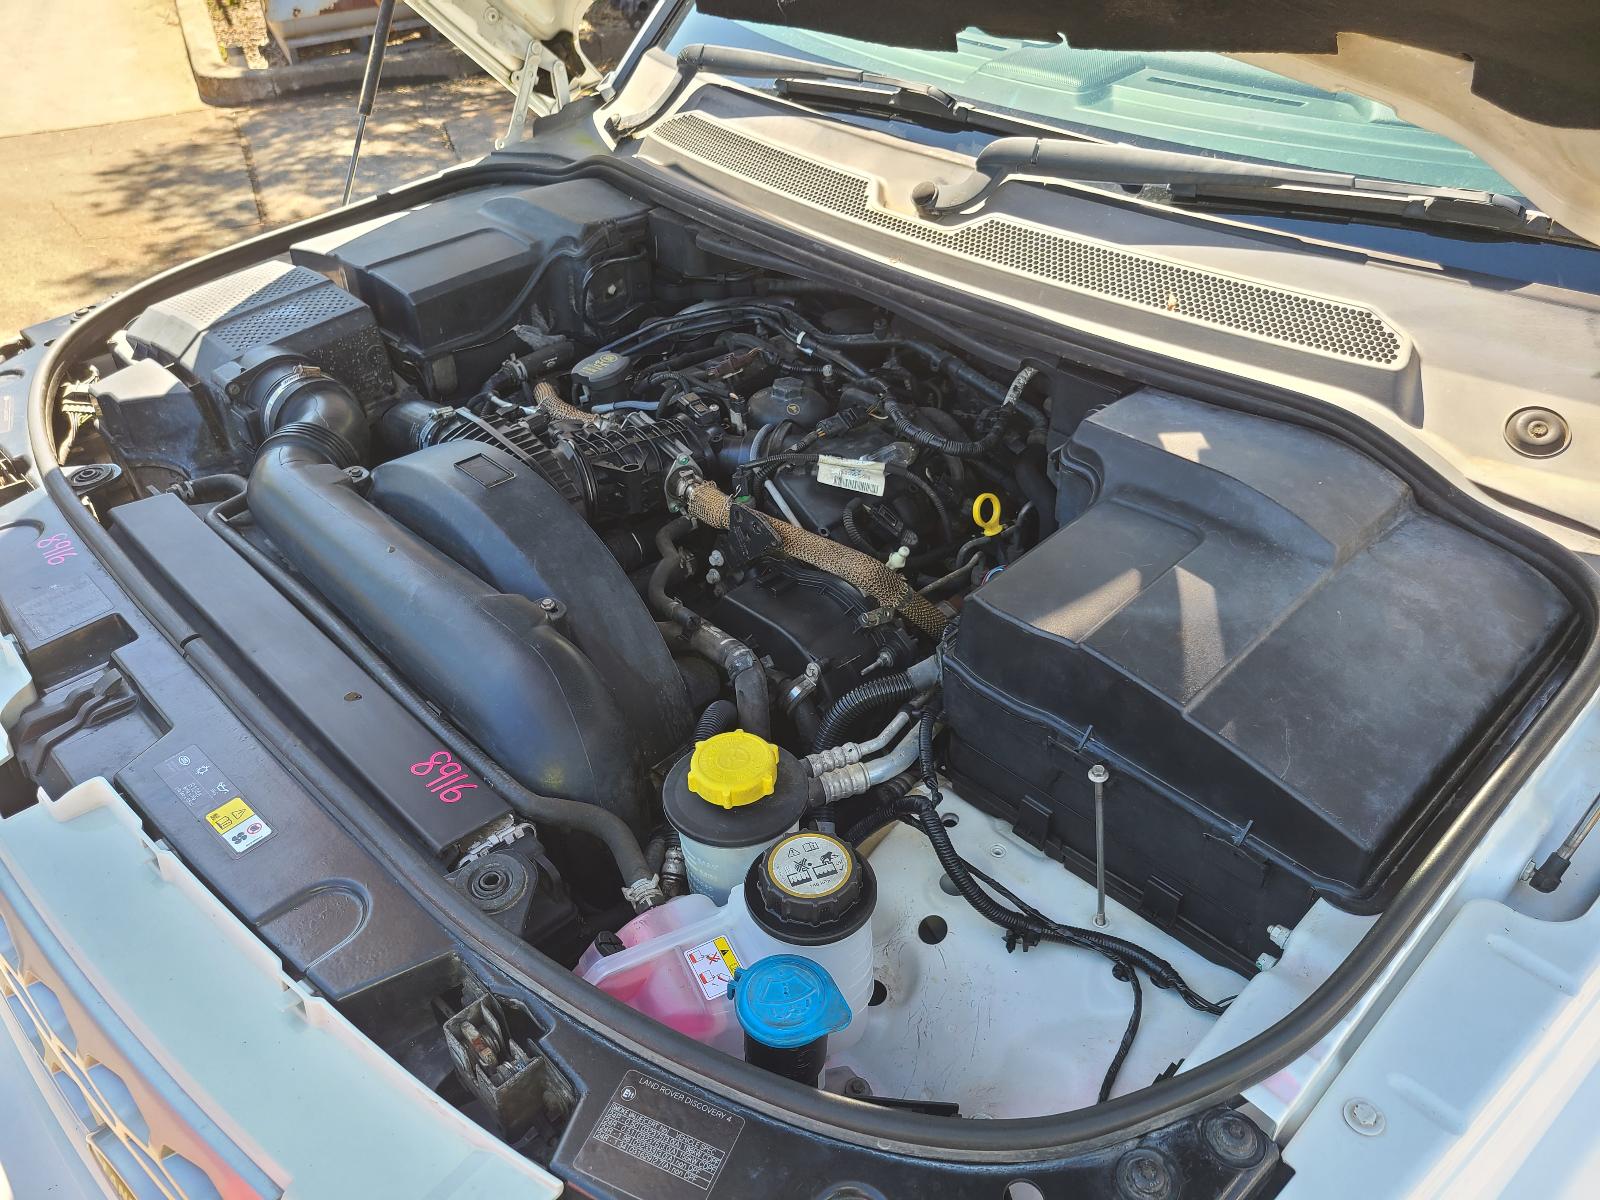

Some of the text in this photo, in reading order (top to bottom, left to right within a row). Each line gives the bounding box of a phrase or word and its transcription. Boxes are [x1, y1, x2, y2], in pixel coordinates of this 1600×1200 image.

[36, 533, 78, 565] 8916
[410, 751, 479, 803] 8916
[639, 1077, 659, 1090] LAND
[660, 1086, 683, 1100] ROVER
[685, 1096, 726, 1118] DISCOVERY
[699, 1143, 716, 1155] SPEC
